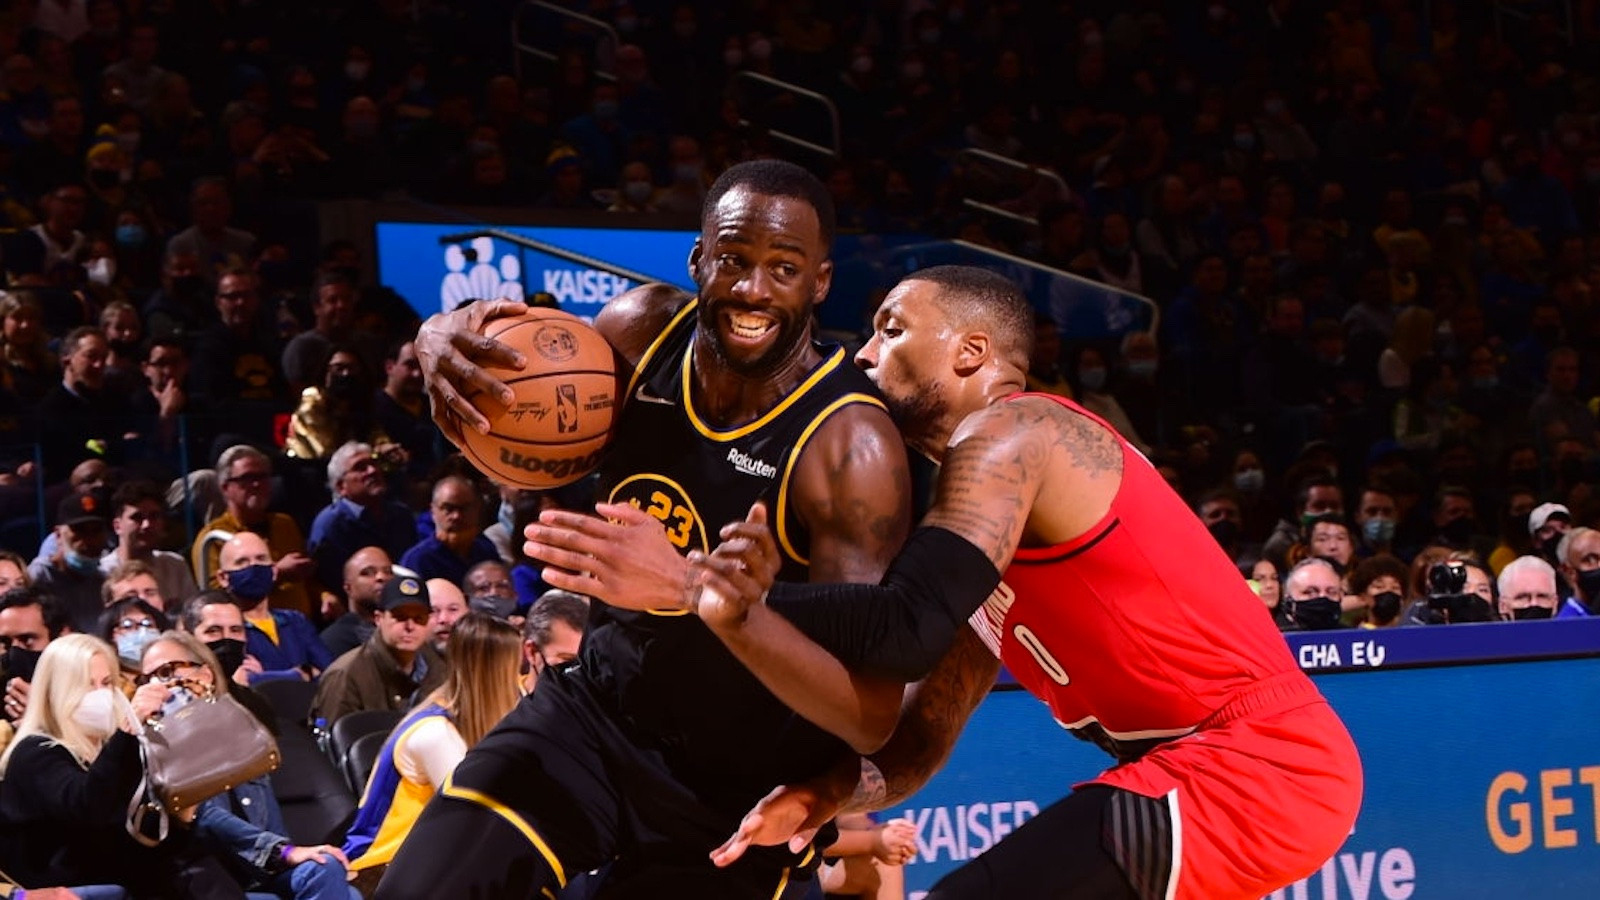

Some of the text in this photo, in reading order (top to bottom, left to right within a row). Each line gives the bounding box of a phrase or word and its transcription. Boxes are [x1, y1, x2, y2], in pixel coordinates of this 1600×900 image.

[727, 447, 777, 479] Rakuten
[1013, 624, 1070, 685] 0
[1299, 644, 1341, 668] CHA
